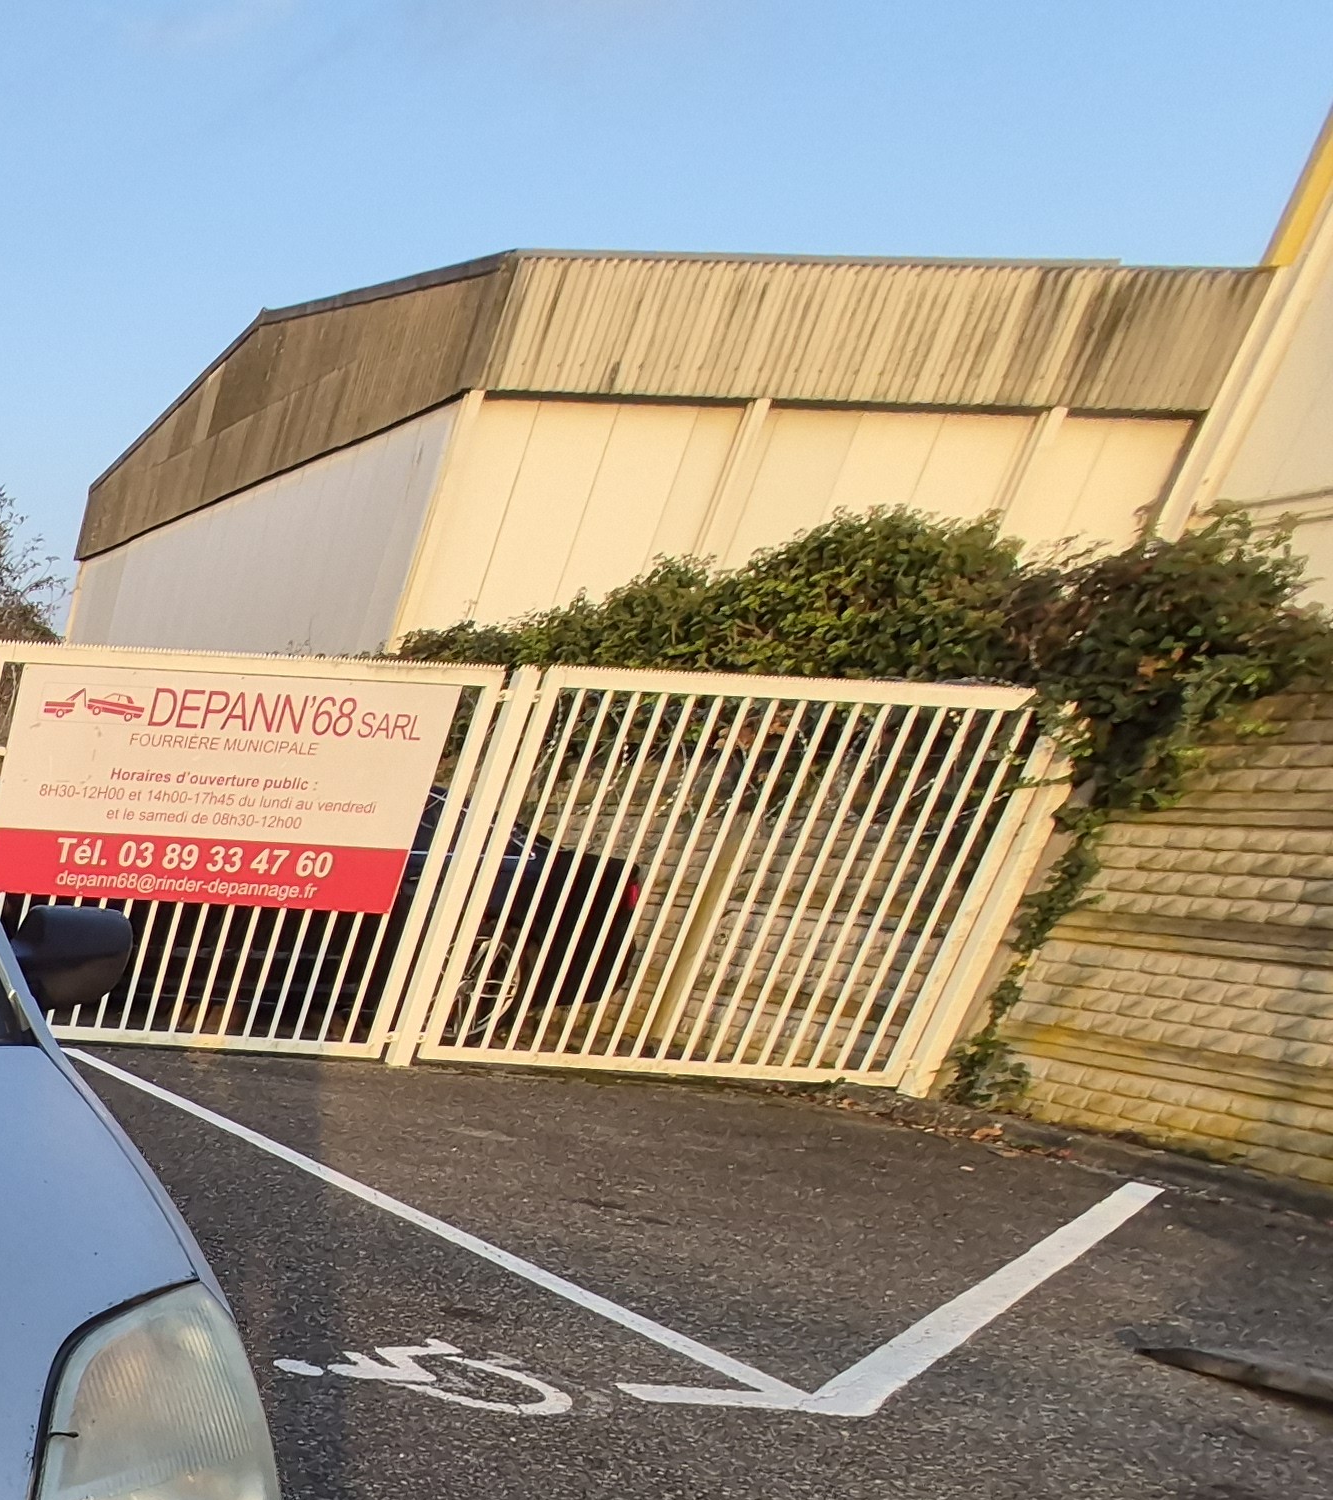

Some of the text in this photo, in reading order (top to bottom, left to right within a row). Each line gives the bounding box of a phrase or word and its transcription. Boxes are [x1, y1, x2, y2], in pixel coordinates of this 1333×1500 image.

[148, 687, 421, 741] DEPANN'68 SARL
[223, 738, 320, 756] MUNICIPALE
[110, 767, 171, 783] Horaires
[176, 771, 259, 788] d'ouverture
[263, 777, 309, 791] public
[39, 783, 377, 814] 8H30-12H00 et 14h00-17h45 du lundi au vendredi
[106, 808, 302, 829] et le samedi de 08h30-12h00
[57, 837, 334, 878] Tél. 03 89 33 47 60
[56, 870, 318, 902] depann68@rinder-depannage.fr
